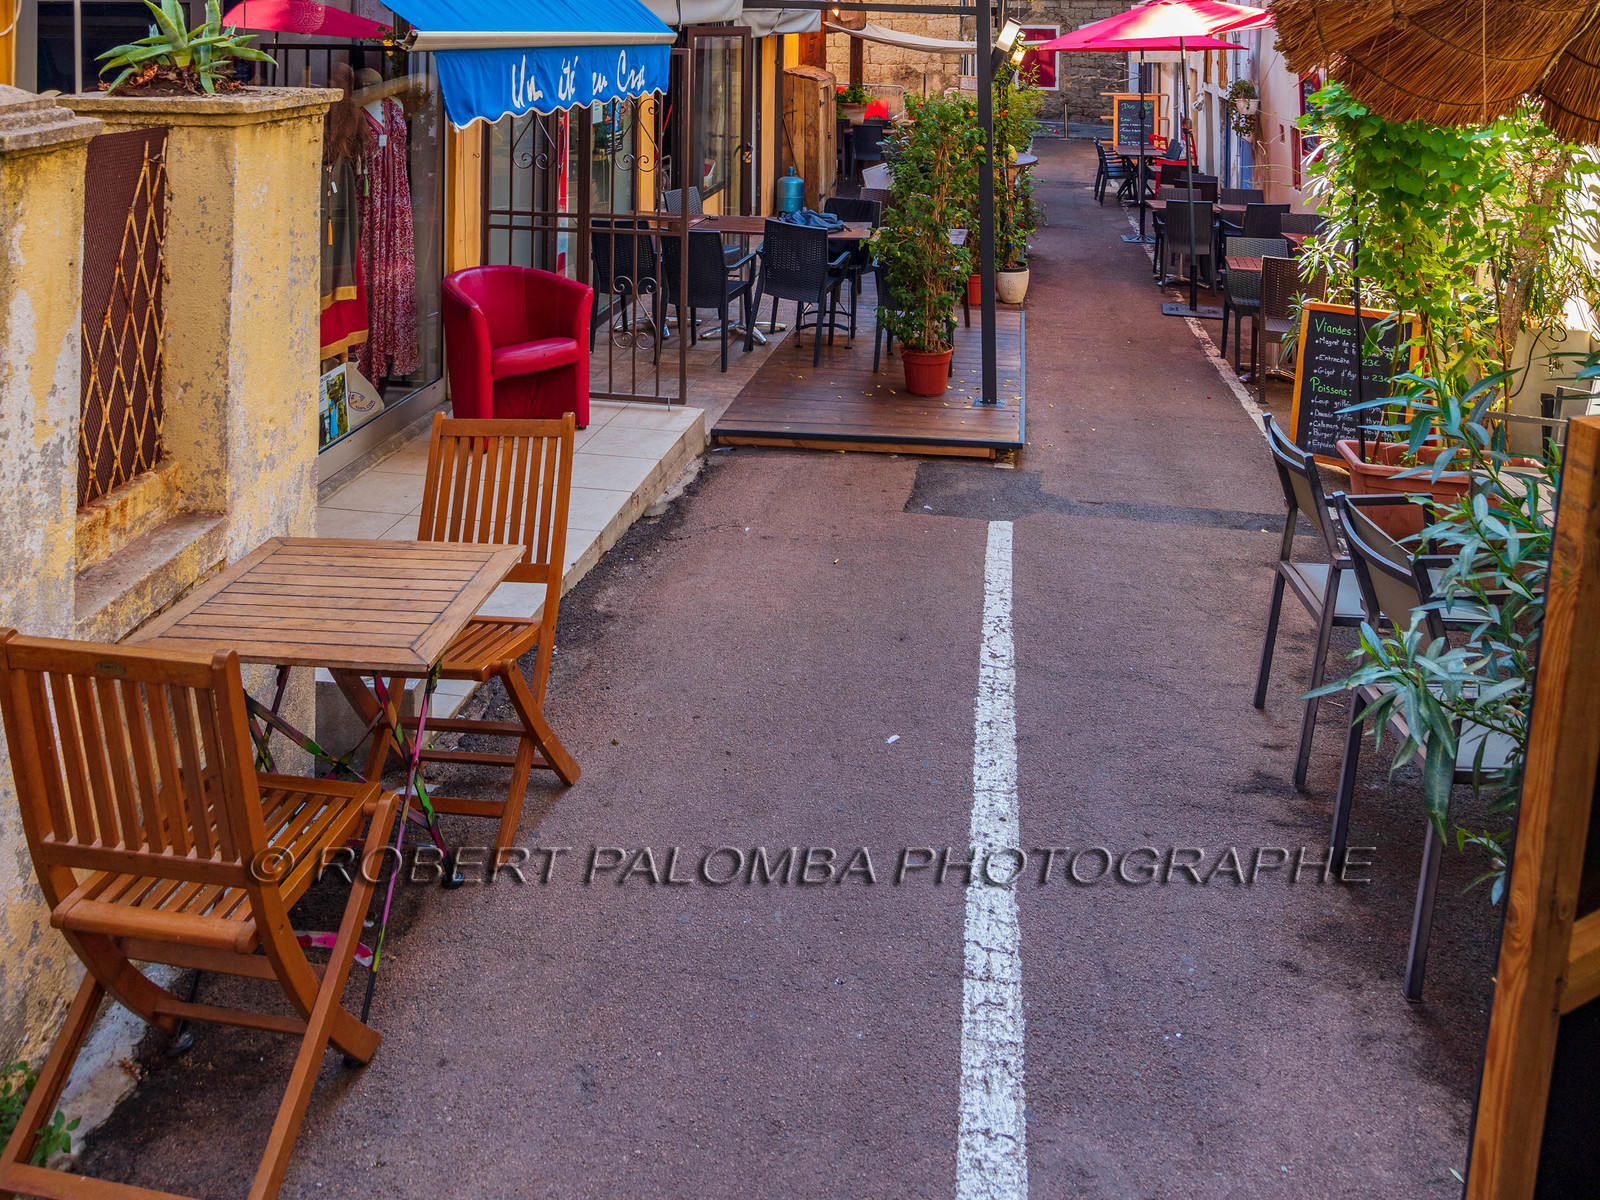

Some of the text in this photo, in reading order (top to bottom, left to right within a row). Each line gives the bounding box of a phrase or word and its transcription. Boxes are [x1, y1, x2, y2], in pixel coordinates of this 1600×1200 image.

[511, 54, 544, 109] Un
[1319, 336, 1340, 347] Magret
[1361, 359, 1381, 367] 23€
[1317, 366, 1336, 378] Gigot
